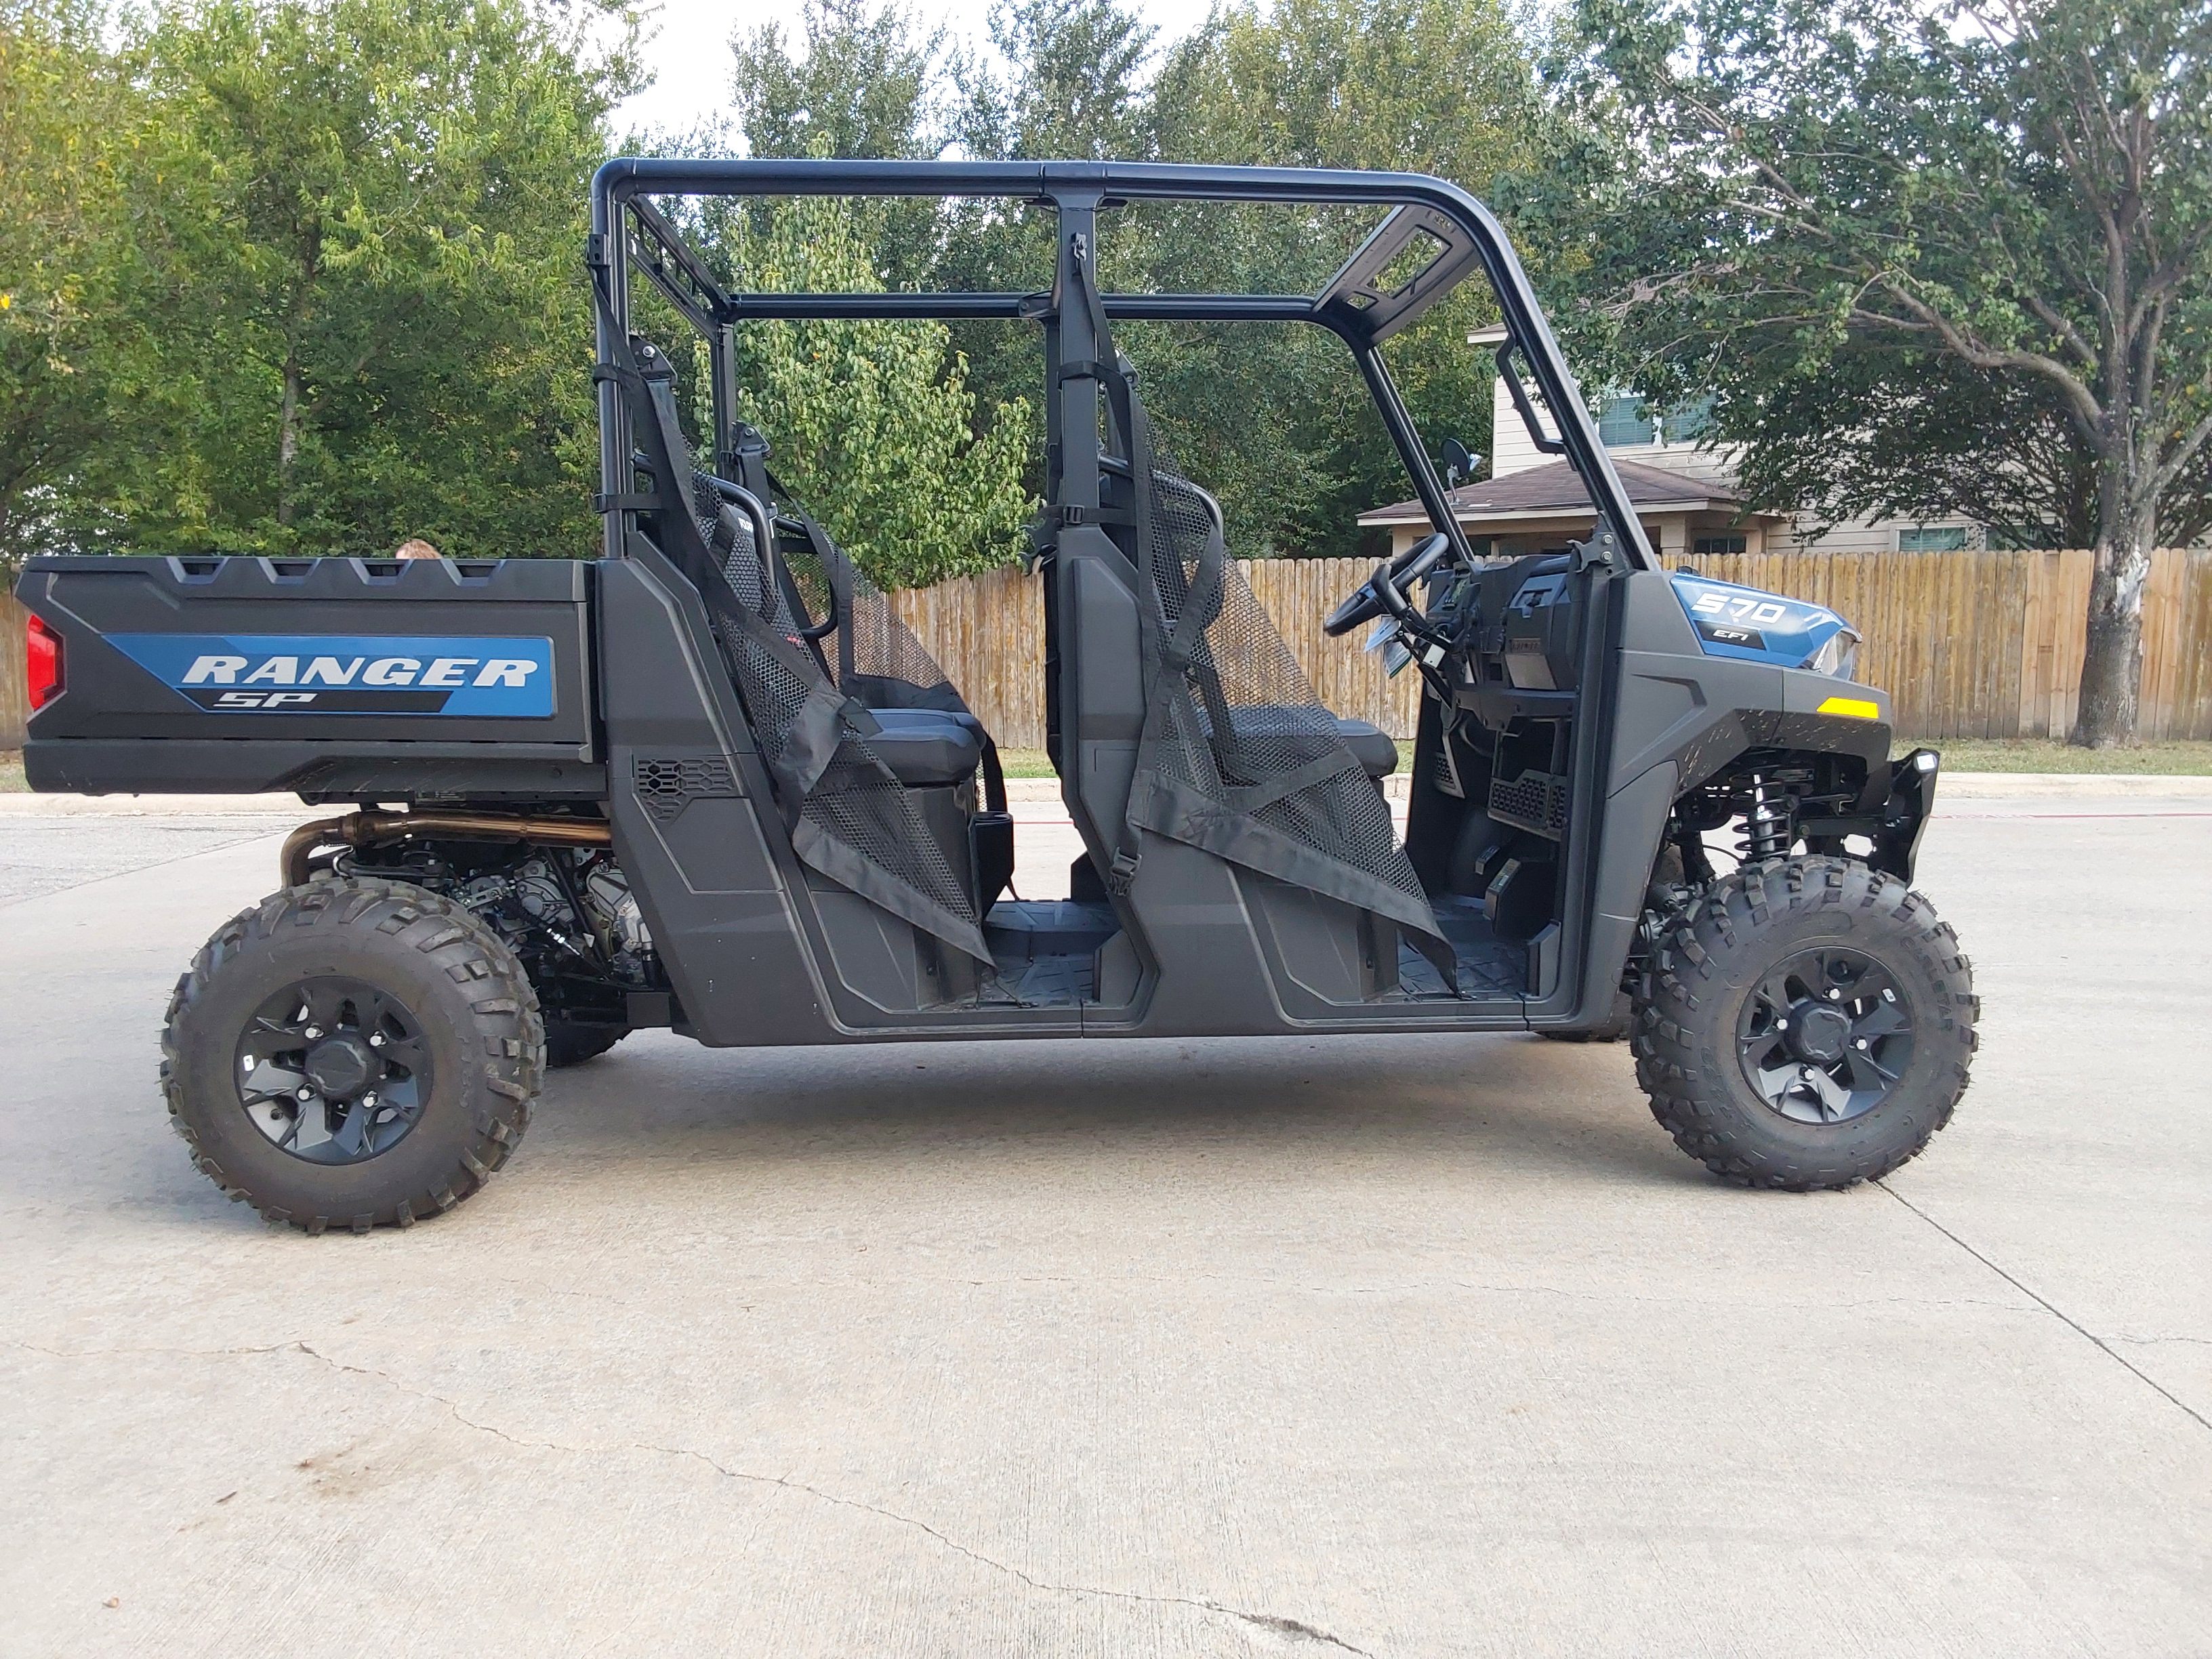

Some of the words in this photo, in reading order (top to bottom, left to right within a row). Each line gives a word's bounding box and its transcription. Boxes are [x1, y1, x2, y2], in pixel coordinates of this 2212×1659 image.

[1691, 592, 1786, 623] 570
[1713, 630, 1749, 641] EFI
[182, 655, 538, 687] RANGER
[213, 692, 318, 708] SP
